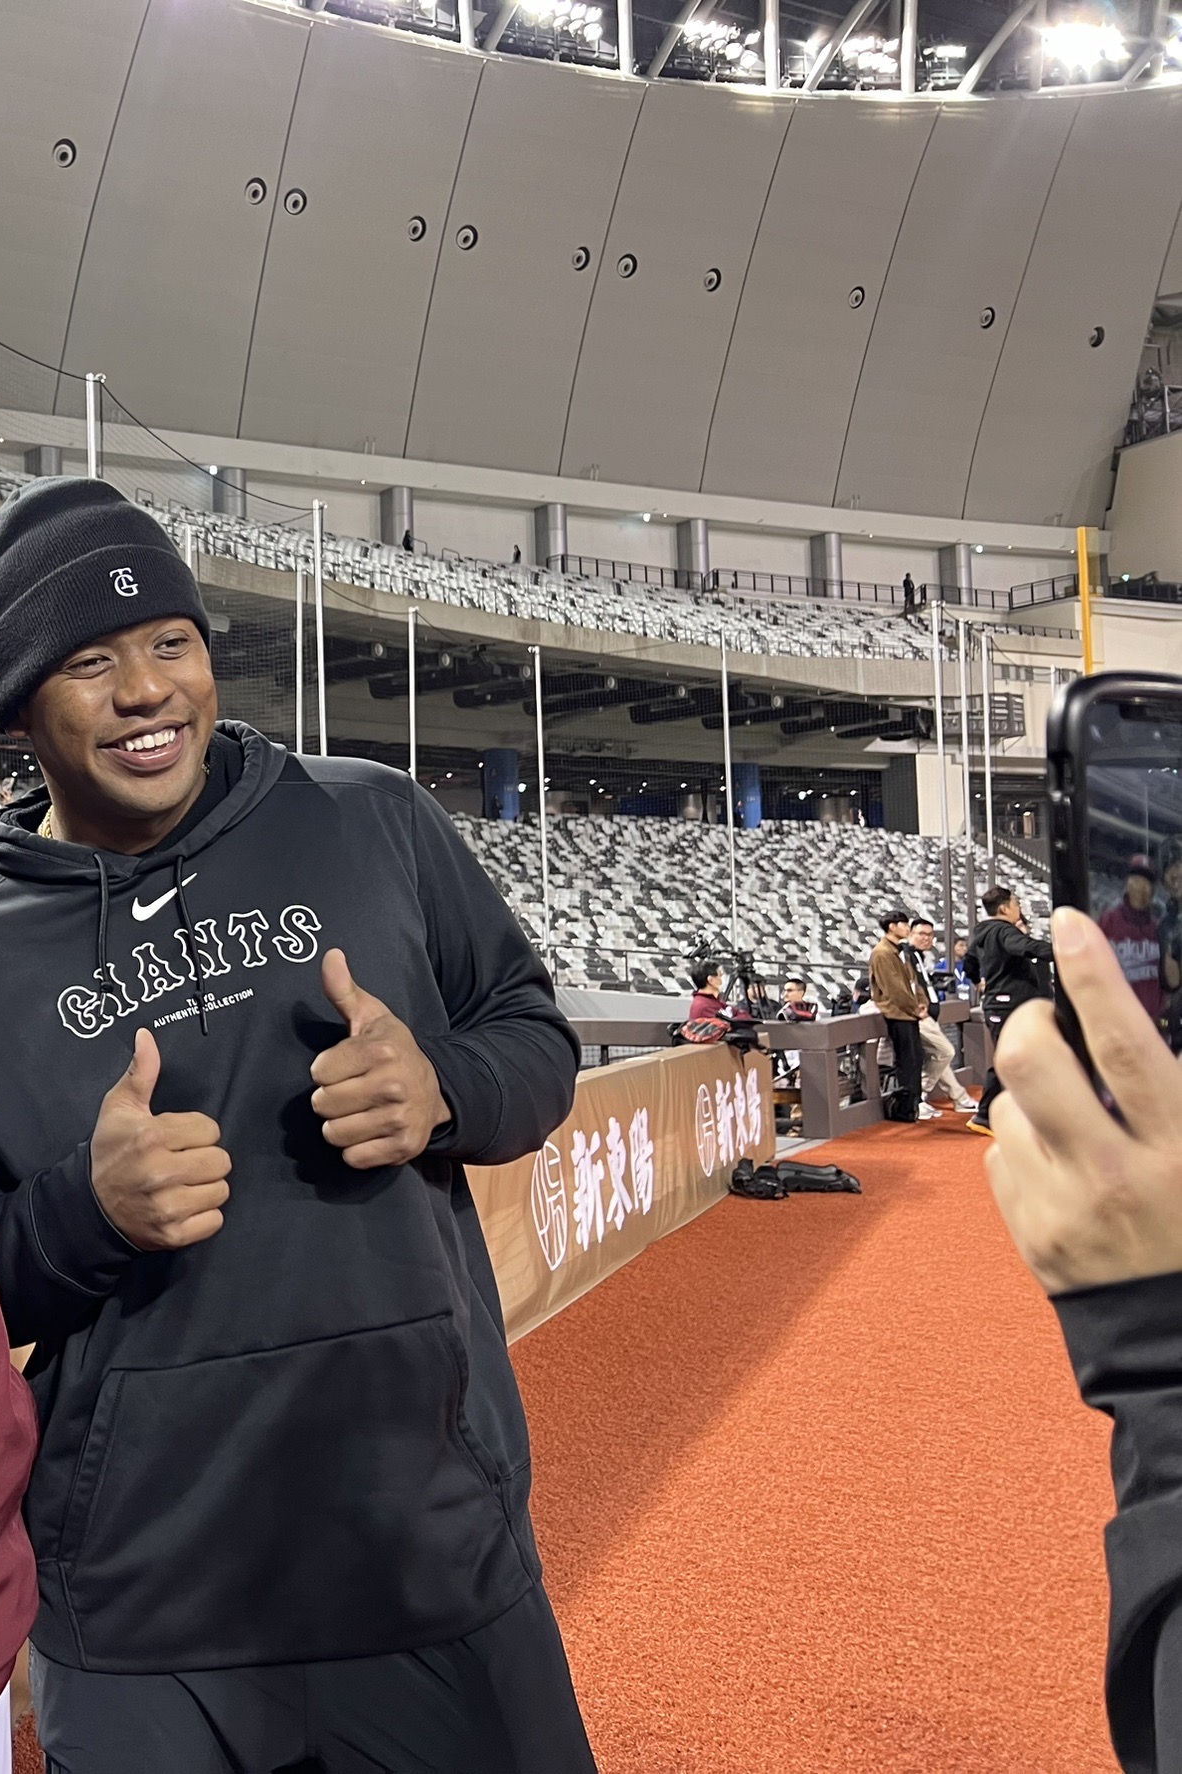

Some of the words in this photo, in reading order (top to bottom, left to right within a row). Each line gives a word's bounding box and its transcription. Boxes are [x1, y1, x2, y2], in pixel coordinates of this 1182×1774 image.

[57, 904, 322, 1039] GIANTS
[153, 1006, 201, 1029] AUTHENTIC
[571, 1107, 654, 1252] 新東陽
